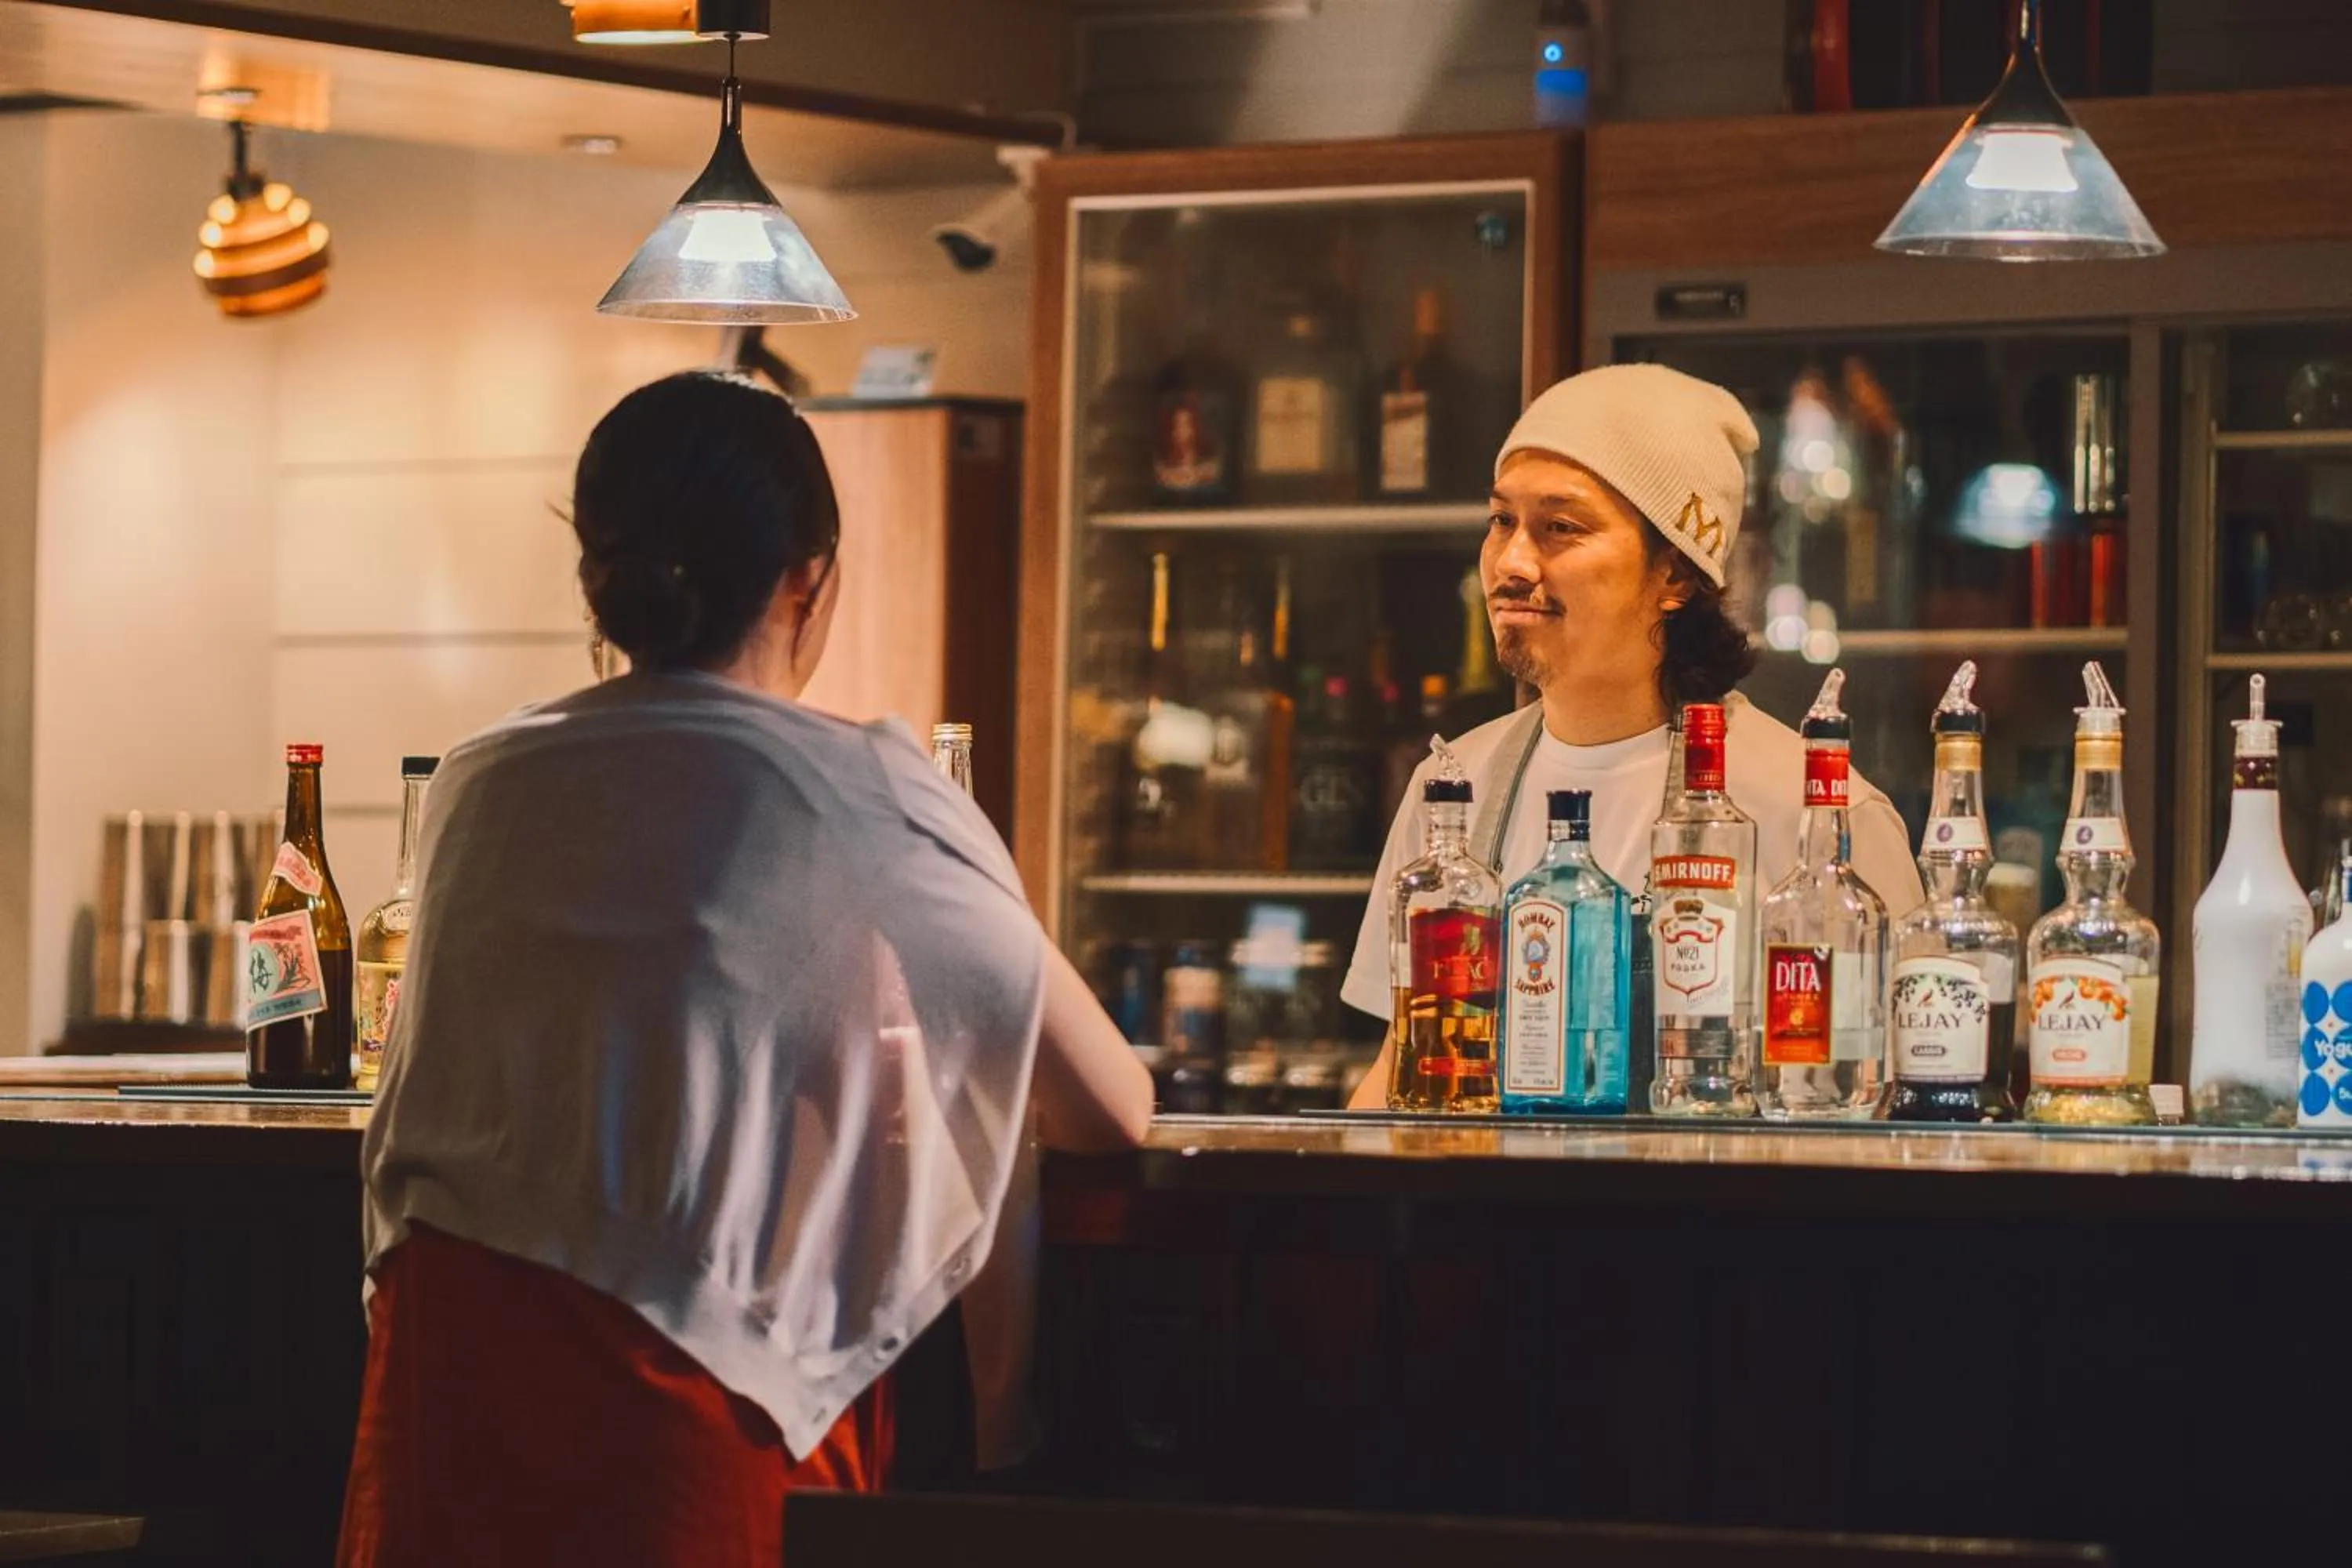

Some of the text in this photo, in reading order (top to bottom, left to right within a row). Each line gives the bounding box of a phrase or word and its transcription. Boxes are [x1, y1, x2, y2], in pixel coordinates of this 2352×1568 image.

[1675, 492, 1723, 559] M
[1654, 862, 1731, 883] SMIRNOFF
[1517, 912, 1556, 929] BOMBAY
[1776, 961, 1821, 992] DITA
[1898, 1011, 1965, 1029] LEJAY
[2038, 1013, 2107, 1032] LEJAY
